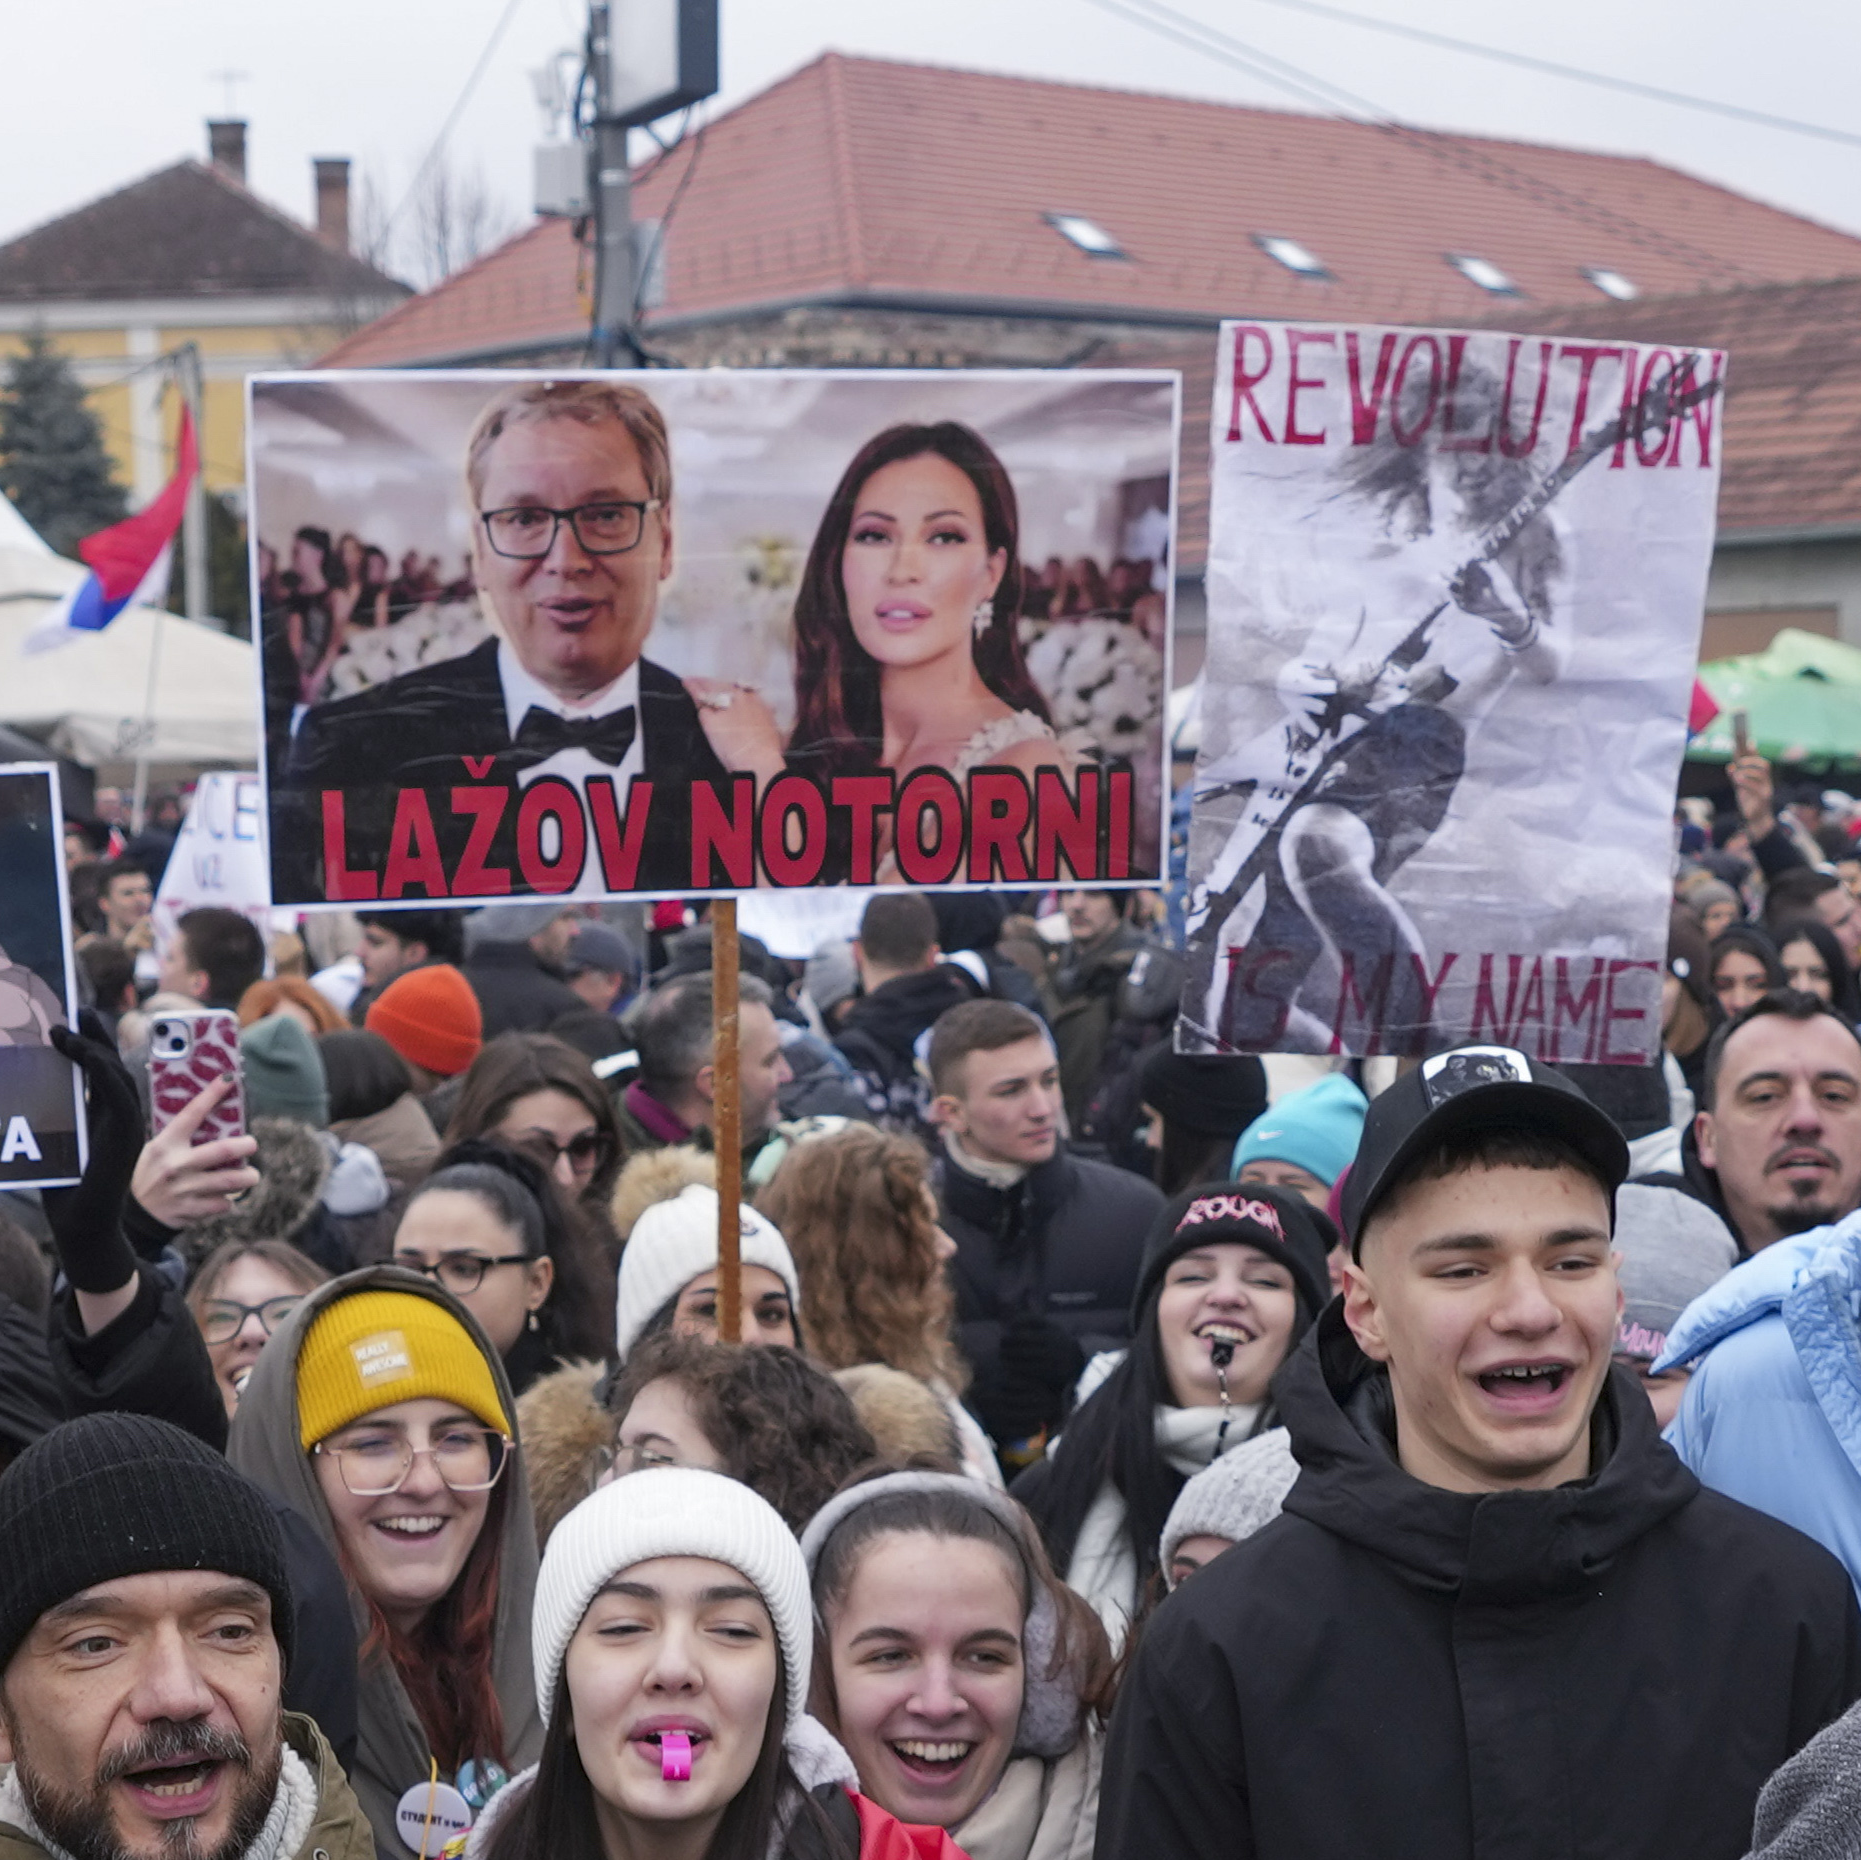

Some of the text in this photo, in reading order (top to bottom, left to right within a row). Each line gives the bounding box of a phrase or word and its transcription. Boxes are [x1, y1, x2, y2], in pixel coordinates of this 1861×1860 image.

[1225, 324, 1729, 470] REVOLUTION
[320, 754, 656, 902] LAŽOV
[688, 765, 1134, 889] NOTORNI
[1223, 945, 1661, 1066] IS MY NAME
[400, 1810, 443, 1826] СТУДНТ
